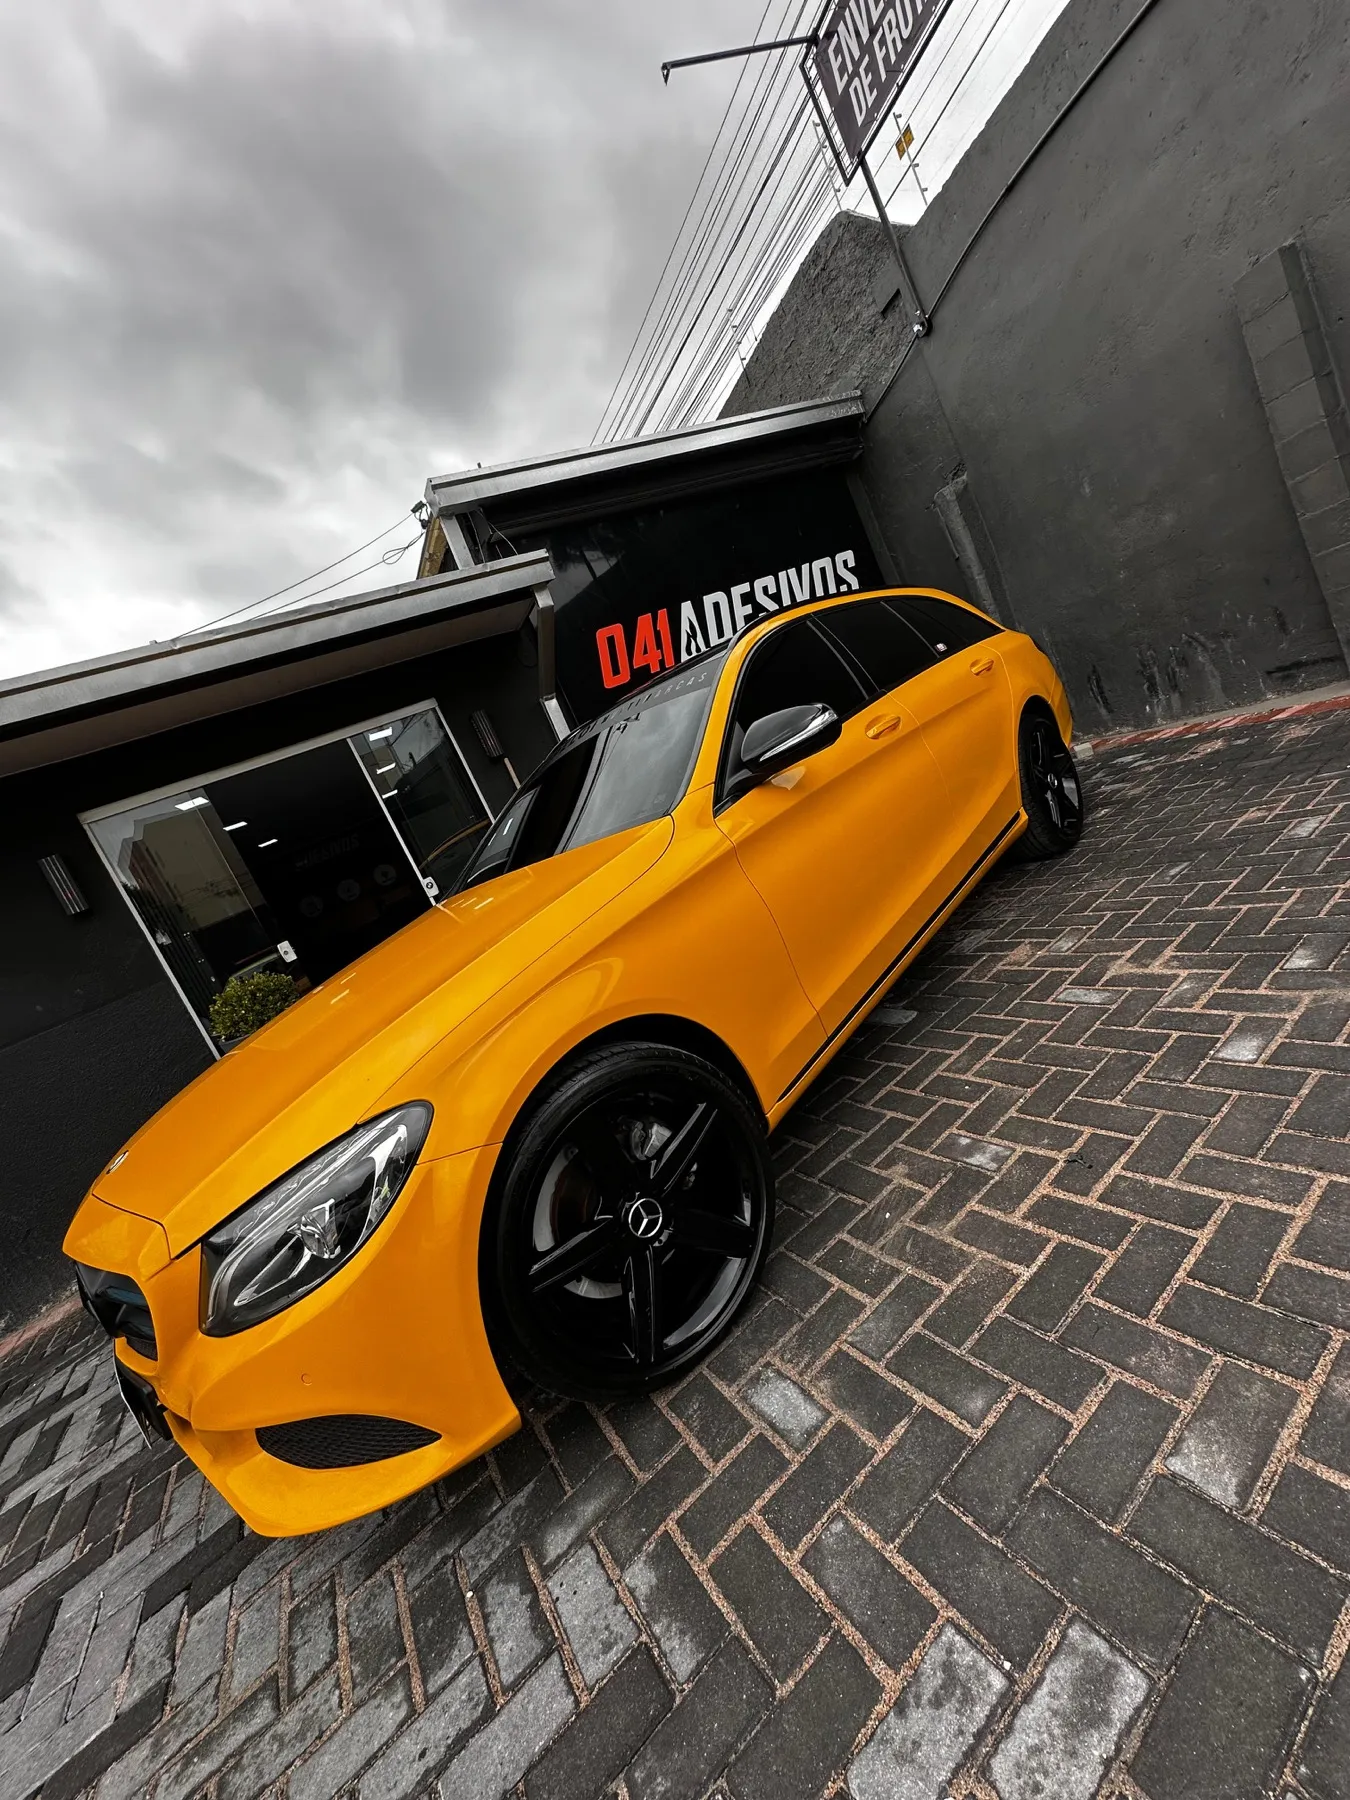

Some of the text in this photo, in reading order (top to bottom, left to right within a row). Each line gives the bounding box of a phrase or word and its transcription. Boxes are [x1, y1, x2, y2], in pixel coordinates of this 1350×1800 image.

[849, 54, 878, 127] DE
[596, 550, 860, 689] 041 ADESIVOS
